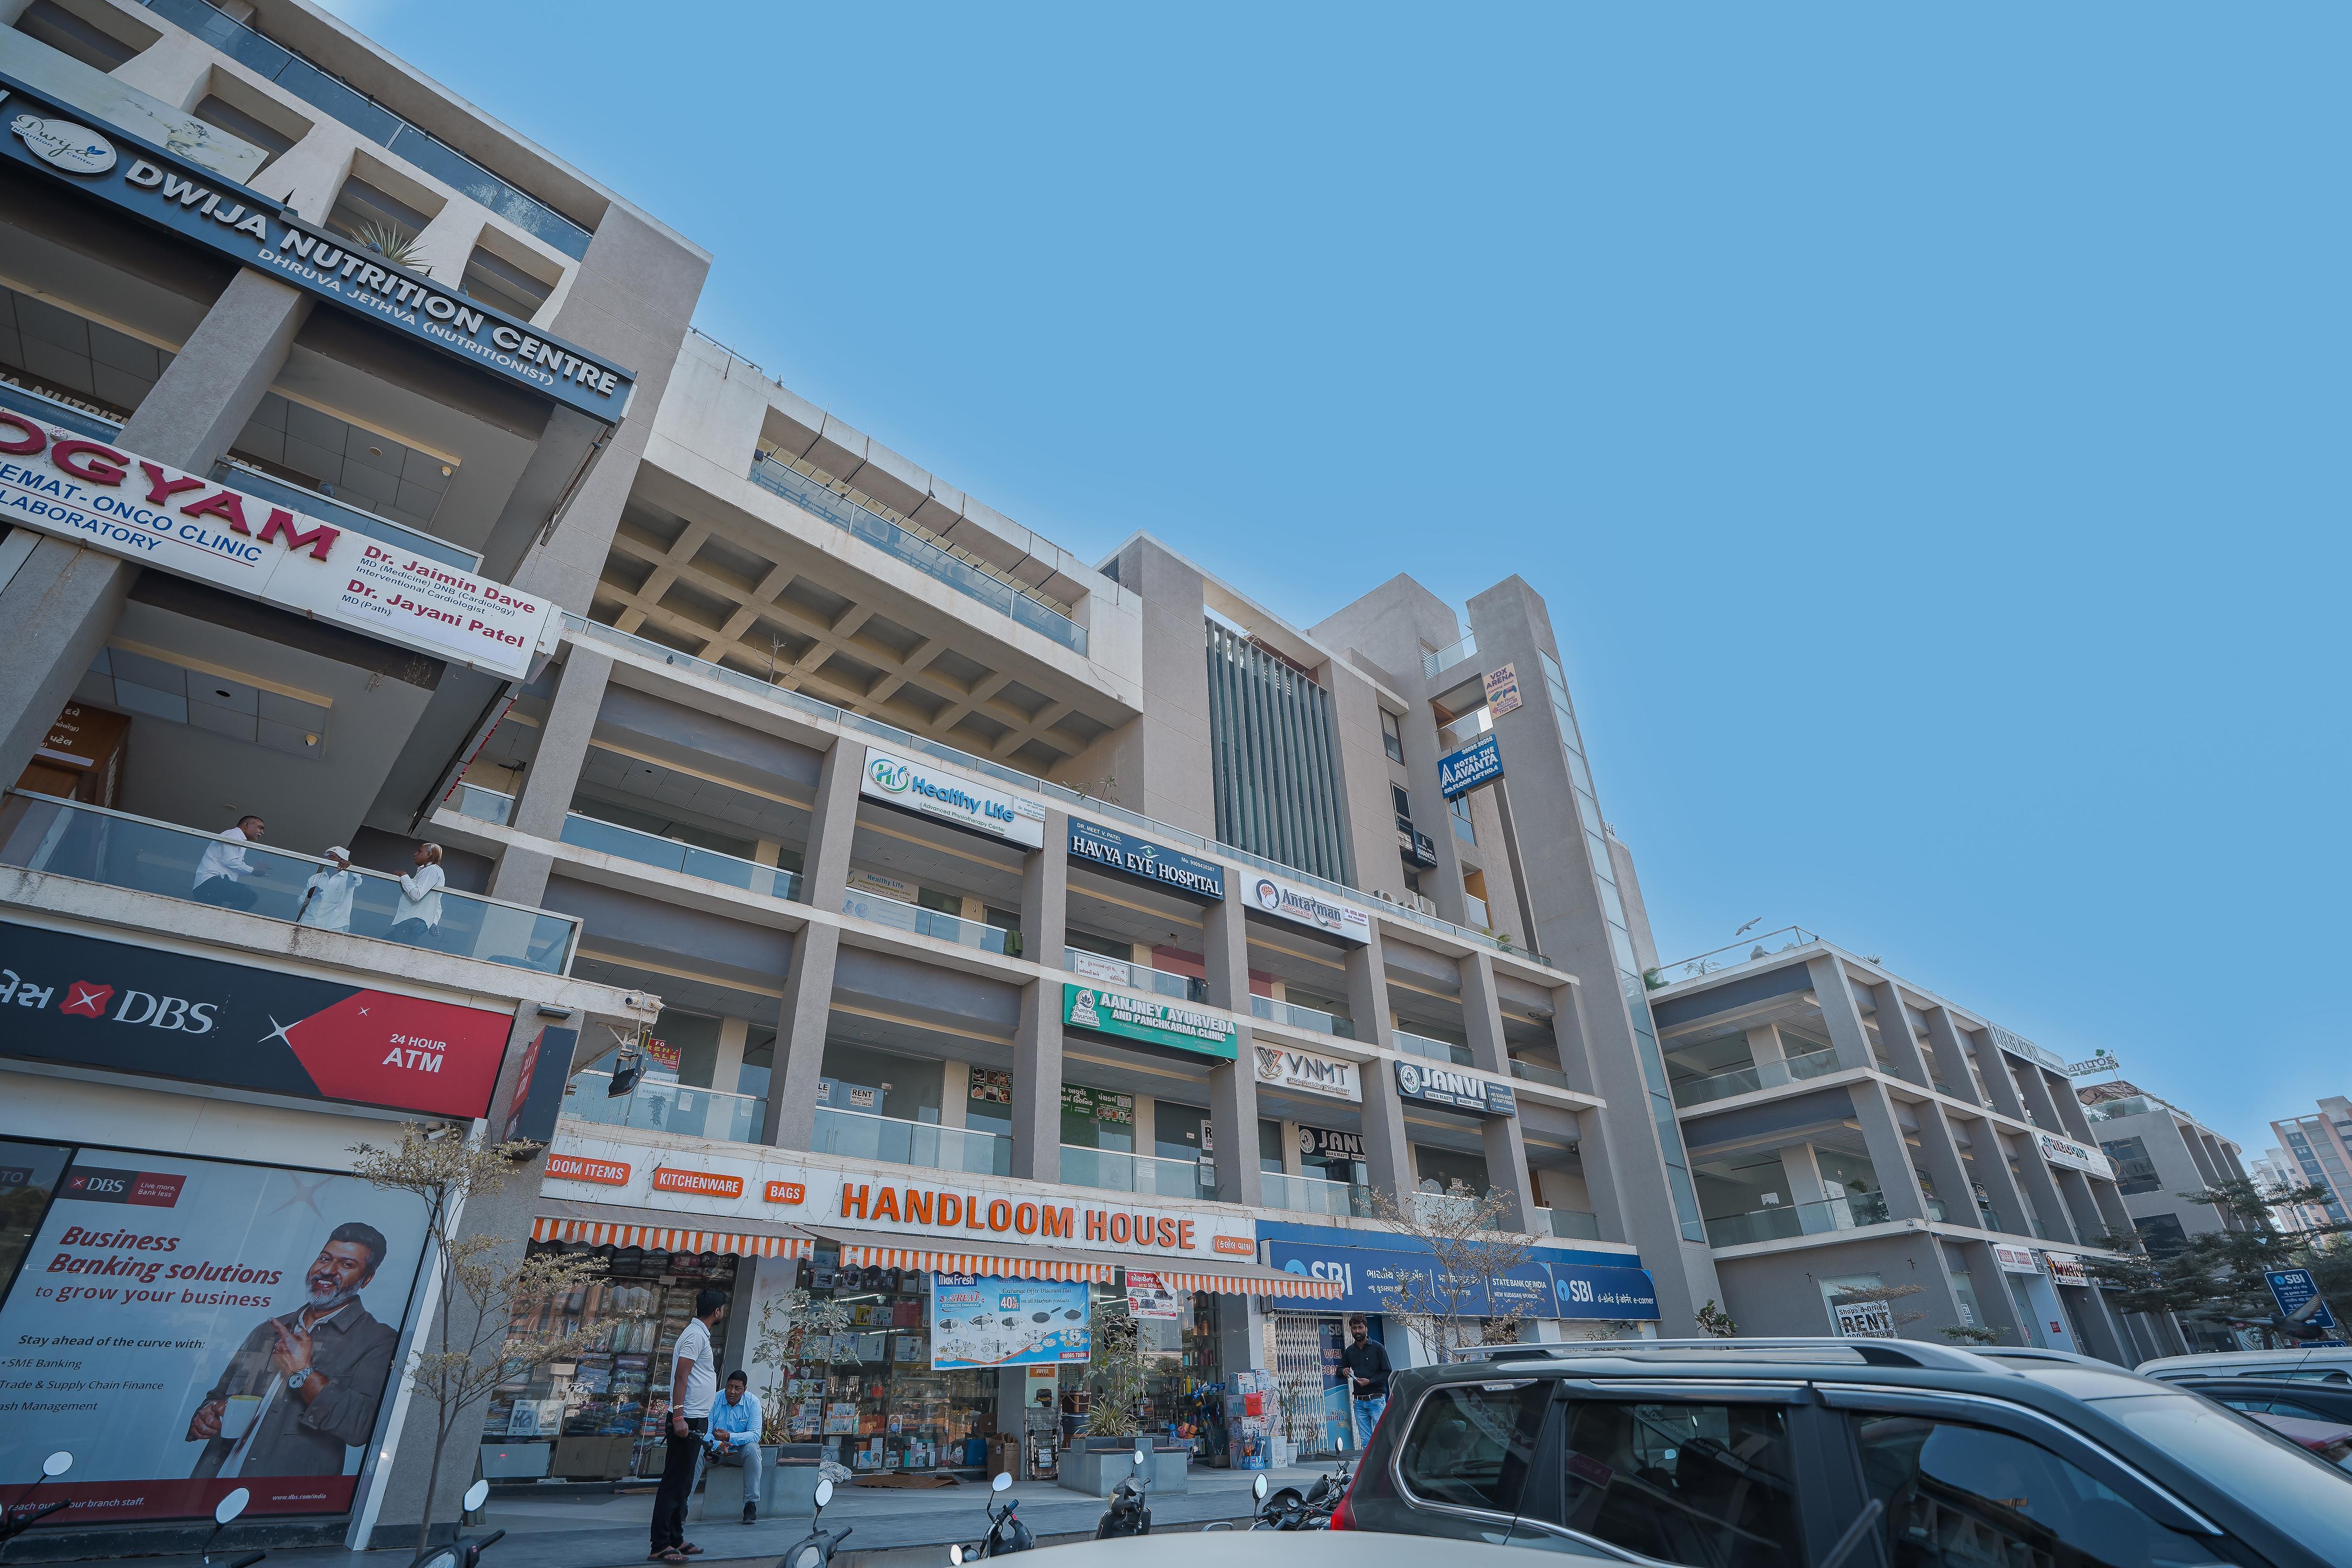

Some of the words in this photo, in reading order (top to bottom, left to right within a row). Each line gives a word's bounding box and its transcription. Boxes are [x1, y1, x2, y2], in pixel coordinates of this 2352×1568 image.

[13, 127, 53, 147] Nutrition
[66, 152, 95, 166] Center
[125, 158, 269, 242] DWIJA
[280, 229, 485, 336] NUTRITION
[492, 326, 618, 398] CENTRE
[258, 248, 341, 293] DHRUVA
[347, 289, 416, 326] JETHVA
[422, 321, 554, 386] (NUTRITIONIST)
[0, 489, 163, 551] LABORATORY
[93, 495, 173, 531] ONCO
[179, 524, 263, 562] CLINIC
[360, 558, 377, 569] MD
[380, 564, 431, 587] (Medicine)
[433, 582, 456, 595] DNB
[458, 591, 516, 617] (Cardiology)
[364, 545, 394, 565] Dr.
[402, 560, 476, 594] Jaimin
[483, 586, 536, 614] Dave
[355, 566, 425, 594] Interventional
[428, 589, 486, 616] Cardiologist
[341, 595, 360, 606] MD
[361, 600, 393, 618] (Path)
[346, 578, 378, 599] Dr.
[386, 594, 463, 627] Jayani
[468, 618, 525, 648] Patel
[1486, 672, 1515, 690] ARENA
[1490, 667, 1507, 680] VDX
[1454, 755, 1479, 770] HOTEL
[1479, 746, 1495, 758] THE
[1455, 753, 1499, 782] AVANTA
[1453, 777, 1472, 790] FLOOR
[912, 775, 982, 814] Healthy
[985, 799, 1014, 823] Life
[923, 802, 951, 816] Advanced
[951, 811, 987, 828] Physiotherapy
[988, 823, 1006, 833] Center
[1077, 822, 1086, 831] DR.
[1087, 825, 1100, 835] MEET
[1106, 832, 1122, 842] PATEL
[1073, 835, 1123, 866] HAVYA
[1126, 852, 1155, 874] EYE
[1158, 862, 1223, 896] HOSPITAL
[1417, 848, 1436, 862] AVANTA
[867, 874, 891, 886] Healthy
[892, 880, 904, 889] Life
[1282, 905, 1313, 919] PSYCHIATRY
[1328, 919, 1342, 928] CLINIC
[112, 989, 218, 1033] DBS
[1074, 1012, 1099, 1022] Ayurveda
[1075, 1006, 1097, 1016] Aanjney
[1099, 993, 1164, 1019] AANJNEY
[1166, 1008, 1236, 1035] AYURVEDA
[1111, 1009, 1132, 1022] AND
[1133, 1013, 1196, 1037] PANCHKARMA
[1196, 1027, 1226, 1043] CLINIC
[389, 1033, 407, 1046] 24
[408, 1036, 447, 1052] HOUR
[382, 1047, 444, 1074] ATM
[1284, 1052, 1349, 1086] VNMT
[1286, 1077, 1303, 1086] Think
[1420, 1067, 1487, 1100] JANVI
[852, 1089, 873, 1098] RENT
[585, 1165, 625, 1181] ITEMS
[659, 1172, 740, 1194] KITCHENWARE
[86, 1178, 125, 1192] DBS
[770, 1185, 800, 1200] BAGS
[840, 1182, 1074, 1239] HANDLOOM
[1086, 1209, 1196, 1250] HOUSE
[59, 1225, 181, 1252] Business
[47, 1253, 164, 1284] Banking
[165, 1260, 283, 1285] solutions
[2284, 1274, 2305, 1284] SBI
[1492, 1278, 1510, 1287] STATE
[1510, 1279, 1525, 1288] BANK
[1532, 1281, 1548, 1289] INDIA
[1570, 1280, 1594, 1302] SBI
[34, 1285, 54, 1298] to
[56, 1285, 121, 1304] grow
[121, 1289, 176, 1306] your
[180, 1289, 272, 1308] business
[949, 1293, 981, 1302] GREAT
[1840, 1311, 1890, 1333] RENT
[18, 1334, 50, 1347] Stay
[52, 1335, 94, 1346] ahead
[96, 1336, 113, 1346] of
[113, 1337, 135, 1347] the
[137, 1339, 172, 1348] curve
[175, 1339, 205, 1349] with:
[7, 1358, 34, 1367] SME
[36, 1358, 83, 1370] Banking
[0, 1380, 32, 1389] Trade
[35, 1380, 44, 1389] &
[47, 1380, 86, 1391] Supply
[88, 1380, 120, 1390] Chain
[122, 1381, 164, 1390] Finance
[21, 1401, 99, 1412] Management
[87, 1499, 121, 1507] branch
[121, 1497, 144, 1506] staff.
